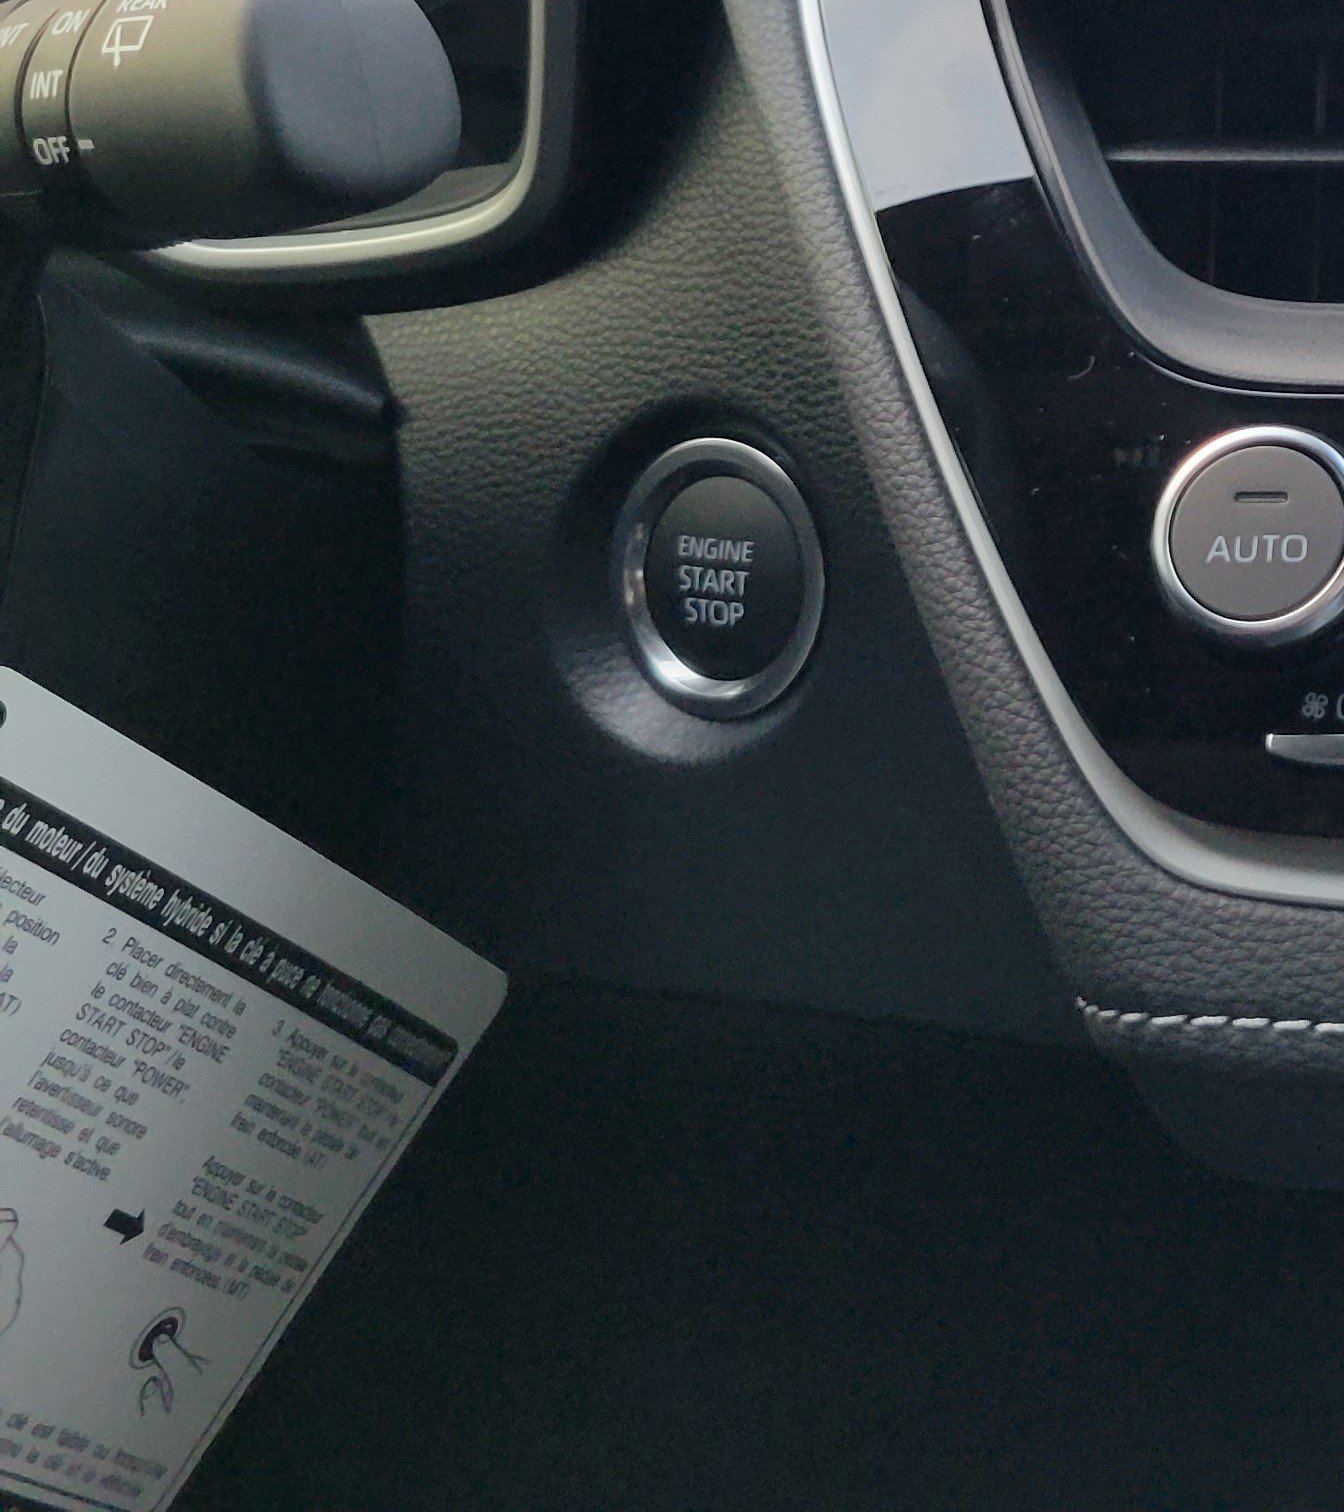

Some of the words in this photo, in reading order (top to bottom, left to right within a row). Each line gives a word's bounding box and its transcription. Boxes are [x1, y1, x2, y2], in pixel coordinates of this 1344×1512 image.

[0, 23, 29, 48] NT
[52, 9, 90, 36] ON
[30, 70, 64, 100] INT
[33, 135, 71, 165] OFF
[678, 534, 755, 564] ENGINE
[1206, 532, 1309, 565] AUTO
[679, 565, 750, 598] START
[685, 597, 745, 627] STOP
[2, 802, 31, 836] du
[104, 863, 166, 910] système
[0, 869, 46, 906] lecteur
[5, 910, 60, 946] position
[121, 936, 163, 969] Placer
[164, 963, 235, 1008] directement
[90, 980, 106, 1000] le
[108, 993, 173, 1034] contacteur
[106, 959, 130, 981] clé
[130, 971, 158, 999] bien
[173, 997, 200, 1020] plat
[200, 1012, 238, 1039] contre
[76, 1002, 128, 1038] START
[60, 1029, 128, 1069] contacteur
[93, 1075, 112, 1093] ce
[114, 1085, 140, 1106] que
[105, 1111, 148, 1140] sonore
[95, 1136, 121, 1156] que
